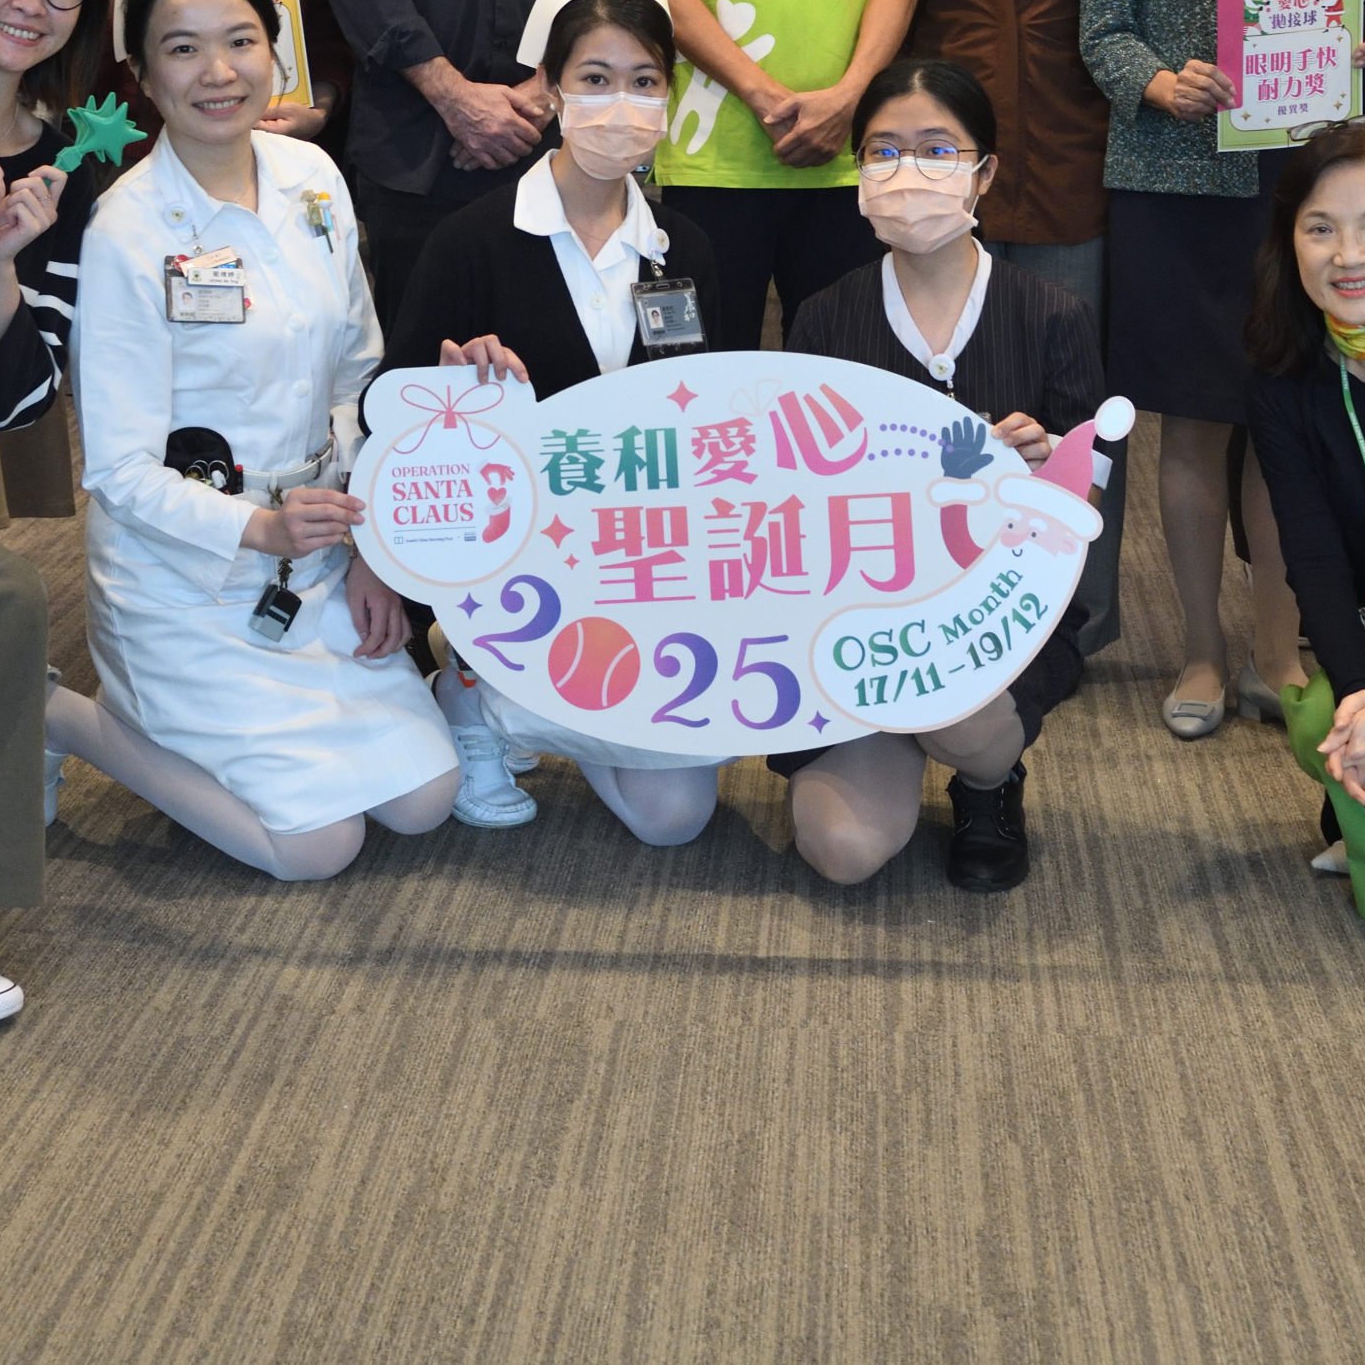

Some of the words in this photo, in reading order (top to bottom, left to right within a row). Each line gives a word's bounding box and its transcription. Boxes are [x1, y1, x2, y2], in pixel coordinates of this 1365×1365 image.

[1270, 10, 1318, 29] 拋接球
[1245, 46, 1337, 76] 眼明手快
[1258, 73, 1325, 102] 耐力獎
[539, 383, 868, 497] 養和愛心
[391, 463, 471, 479] OPERATION
[391, 479, 474, 502] SANTA
[392, 502, 475, 526] CLAUS
[591, 492, 916, 605] 聖誕月
[832, 619, 932, 671] OSC
[938, 568, 1024, 645] Month
